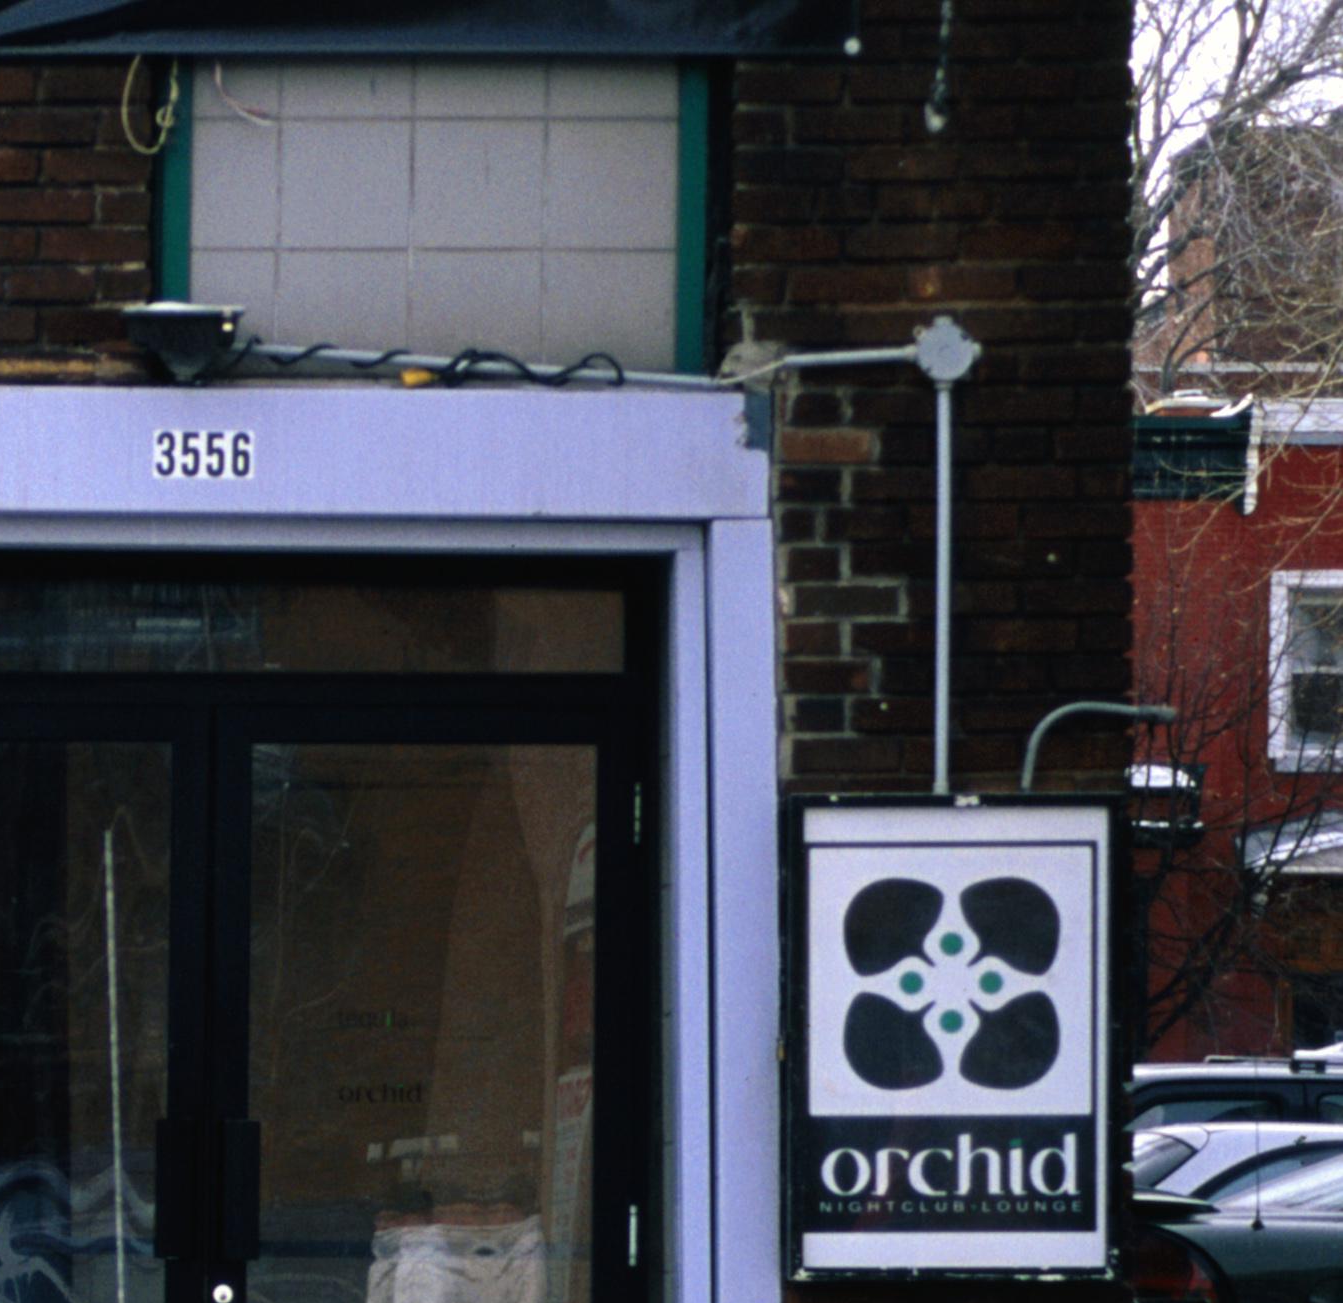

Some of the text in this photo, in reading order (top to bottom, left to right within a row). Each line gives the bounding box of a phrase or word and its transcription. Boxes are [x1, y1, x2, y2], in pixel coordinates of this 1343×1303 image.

[156, 431, 251, 478] 3556
[337, 1082, 425, 1104] orchid
[820, 1132, 1081, 1197] orchid
